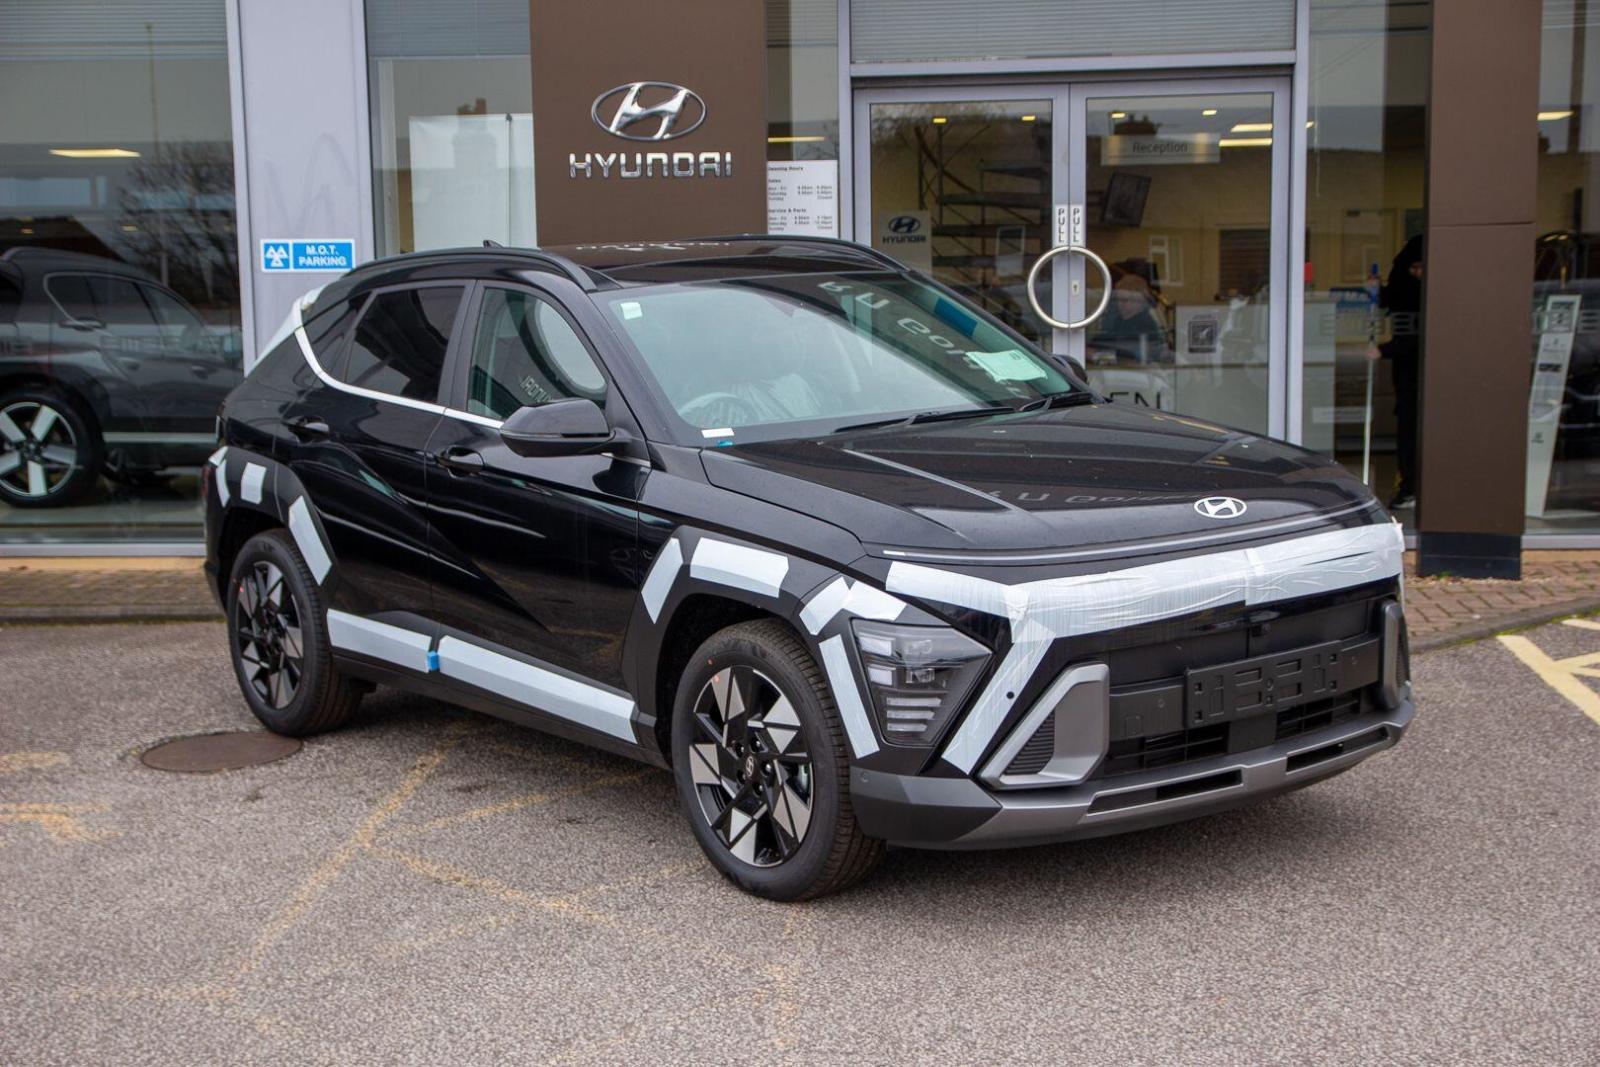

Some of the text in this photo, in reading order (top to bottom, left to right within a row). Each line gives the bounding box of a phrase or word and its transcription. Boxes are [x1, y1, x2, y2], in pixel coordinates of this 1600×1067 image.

[1132, 141, 1188, 154] Reception
[569, 152, 732, 178] HYUNDAI
[1058, 207, 1066, 243] PULL
[1073, 207, 1081, 243] PULL
[882, 234, 927, 244] HYUNDAI
[305, 244, 340, 256] M.O.T.
[298, 256, 347, 267] PARKING
